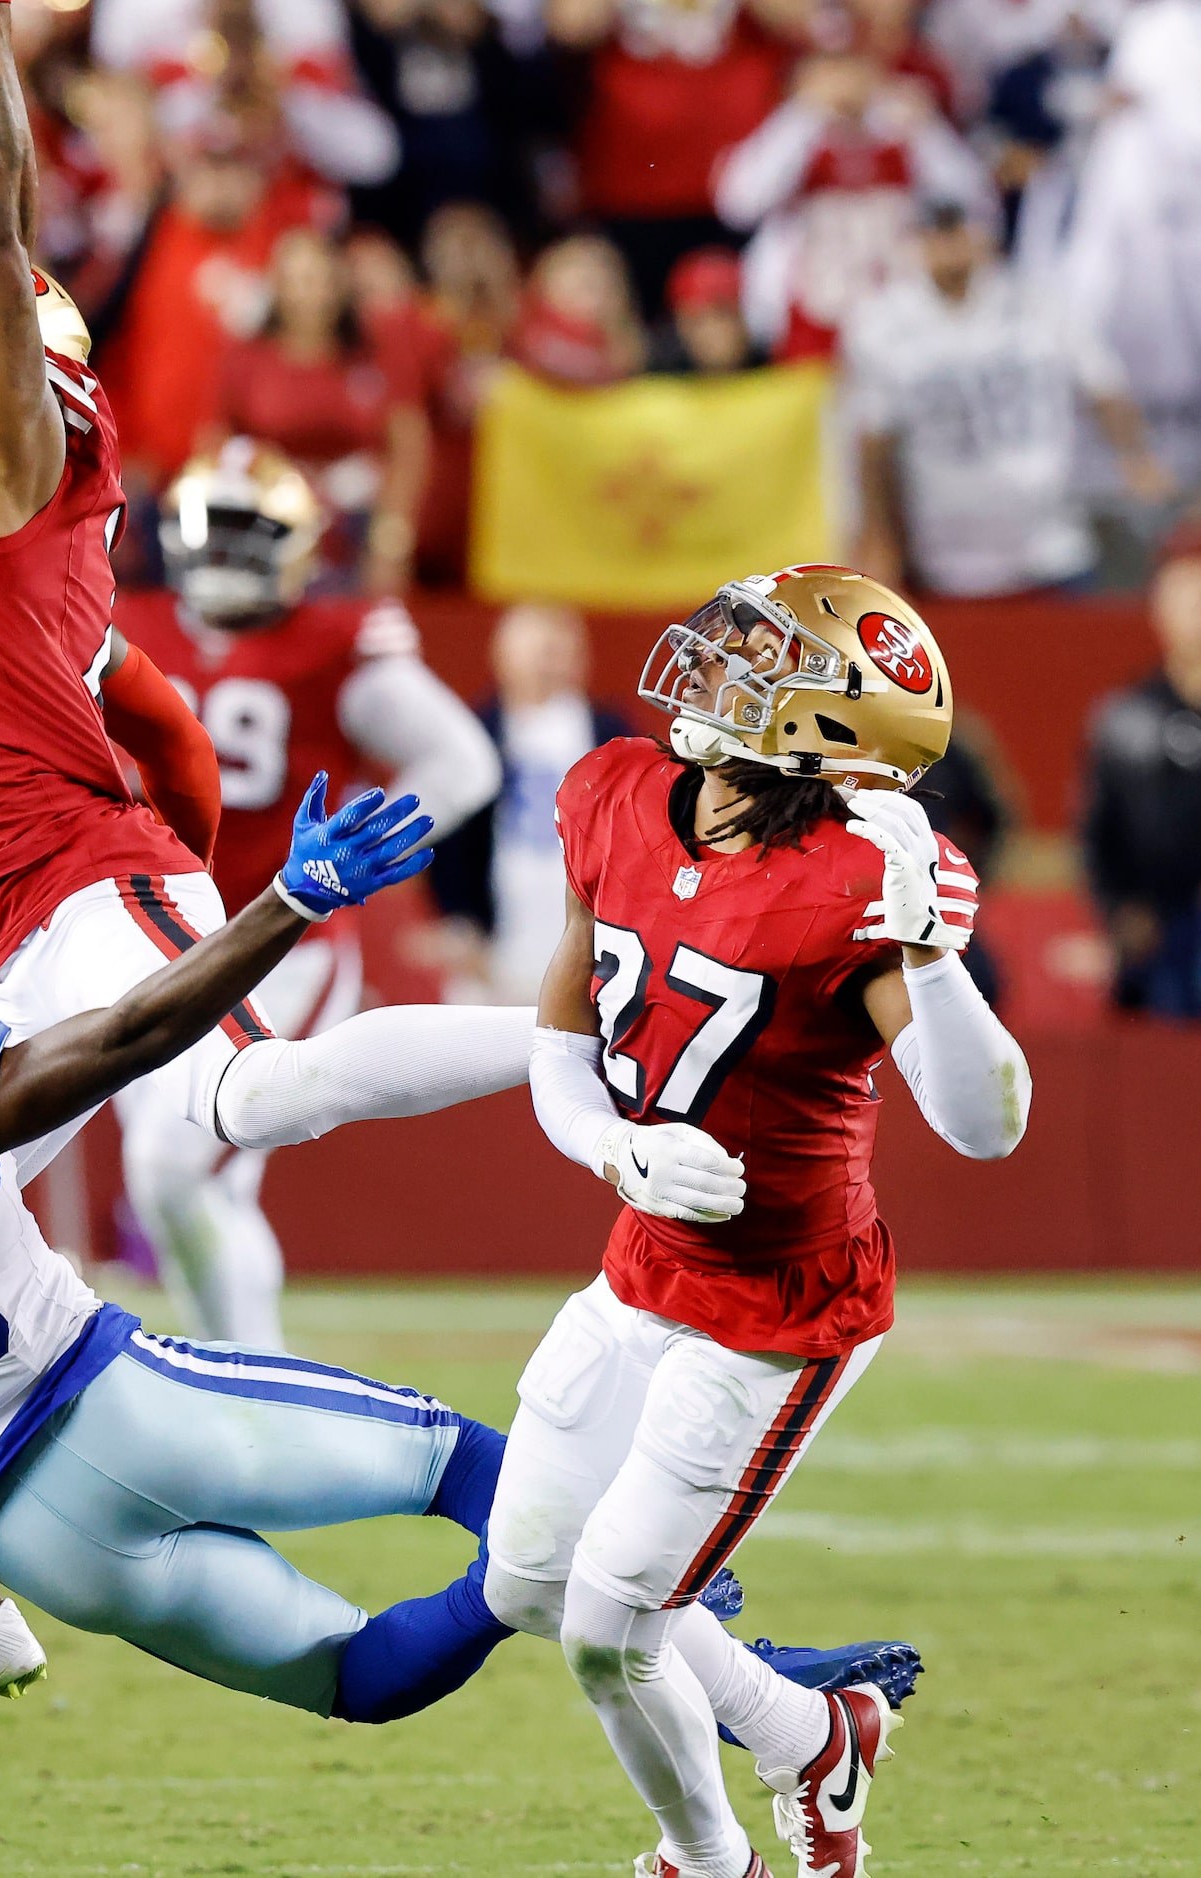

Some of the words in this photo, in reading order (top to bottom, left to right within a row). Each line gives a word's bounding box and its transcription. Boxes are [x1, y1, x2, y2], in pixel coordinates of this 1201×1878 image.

[165, 673, 292, 812] 9
[302, 861, 350, 897] adidas
[594, 917, 779, 1127] 27
